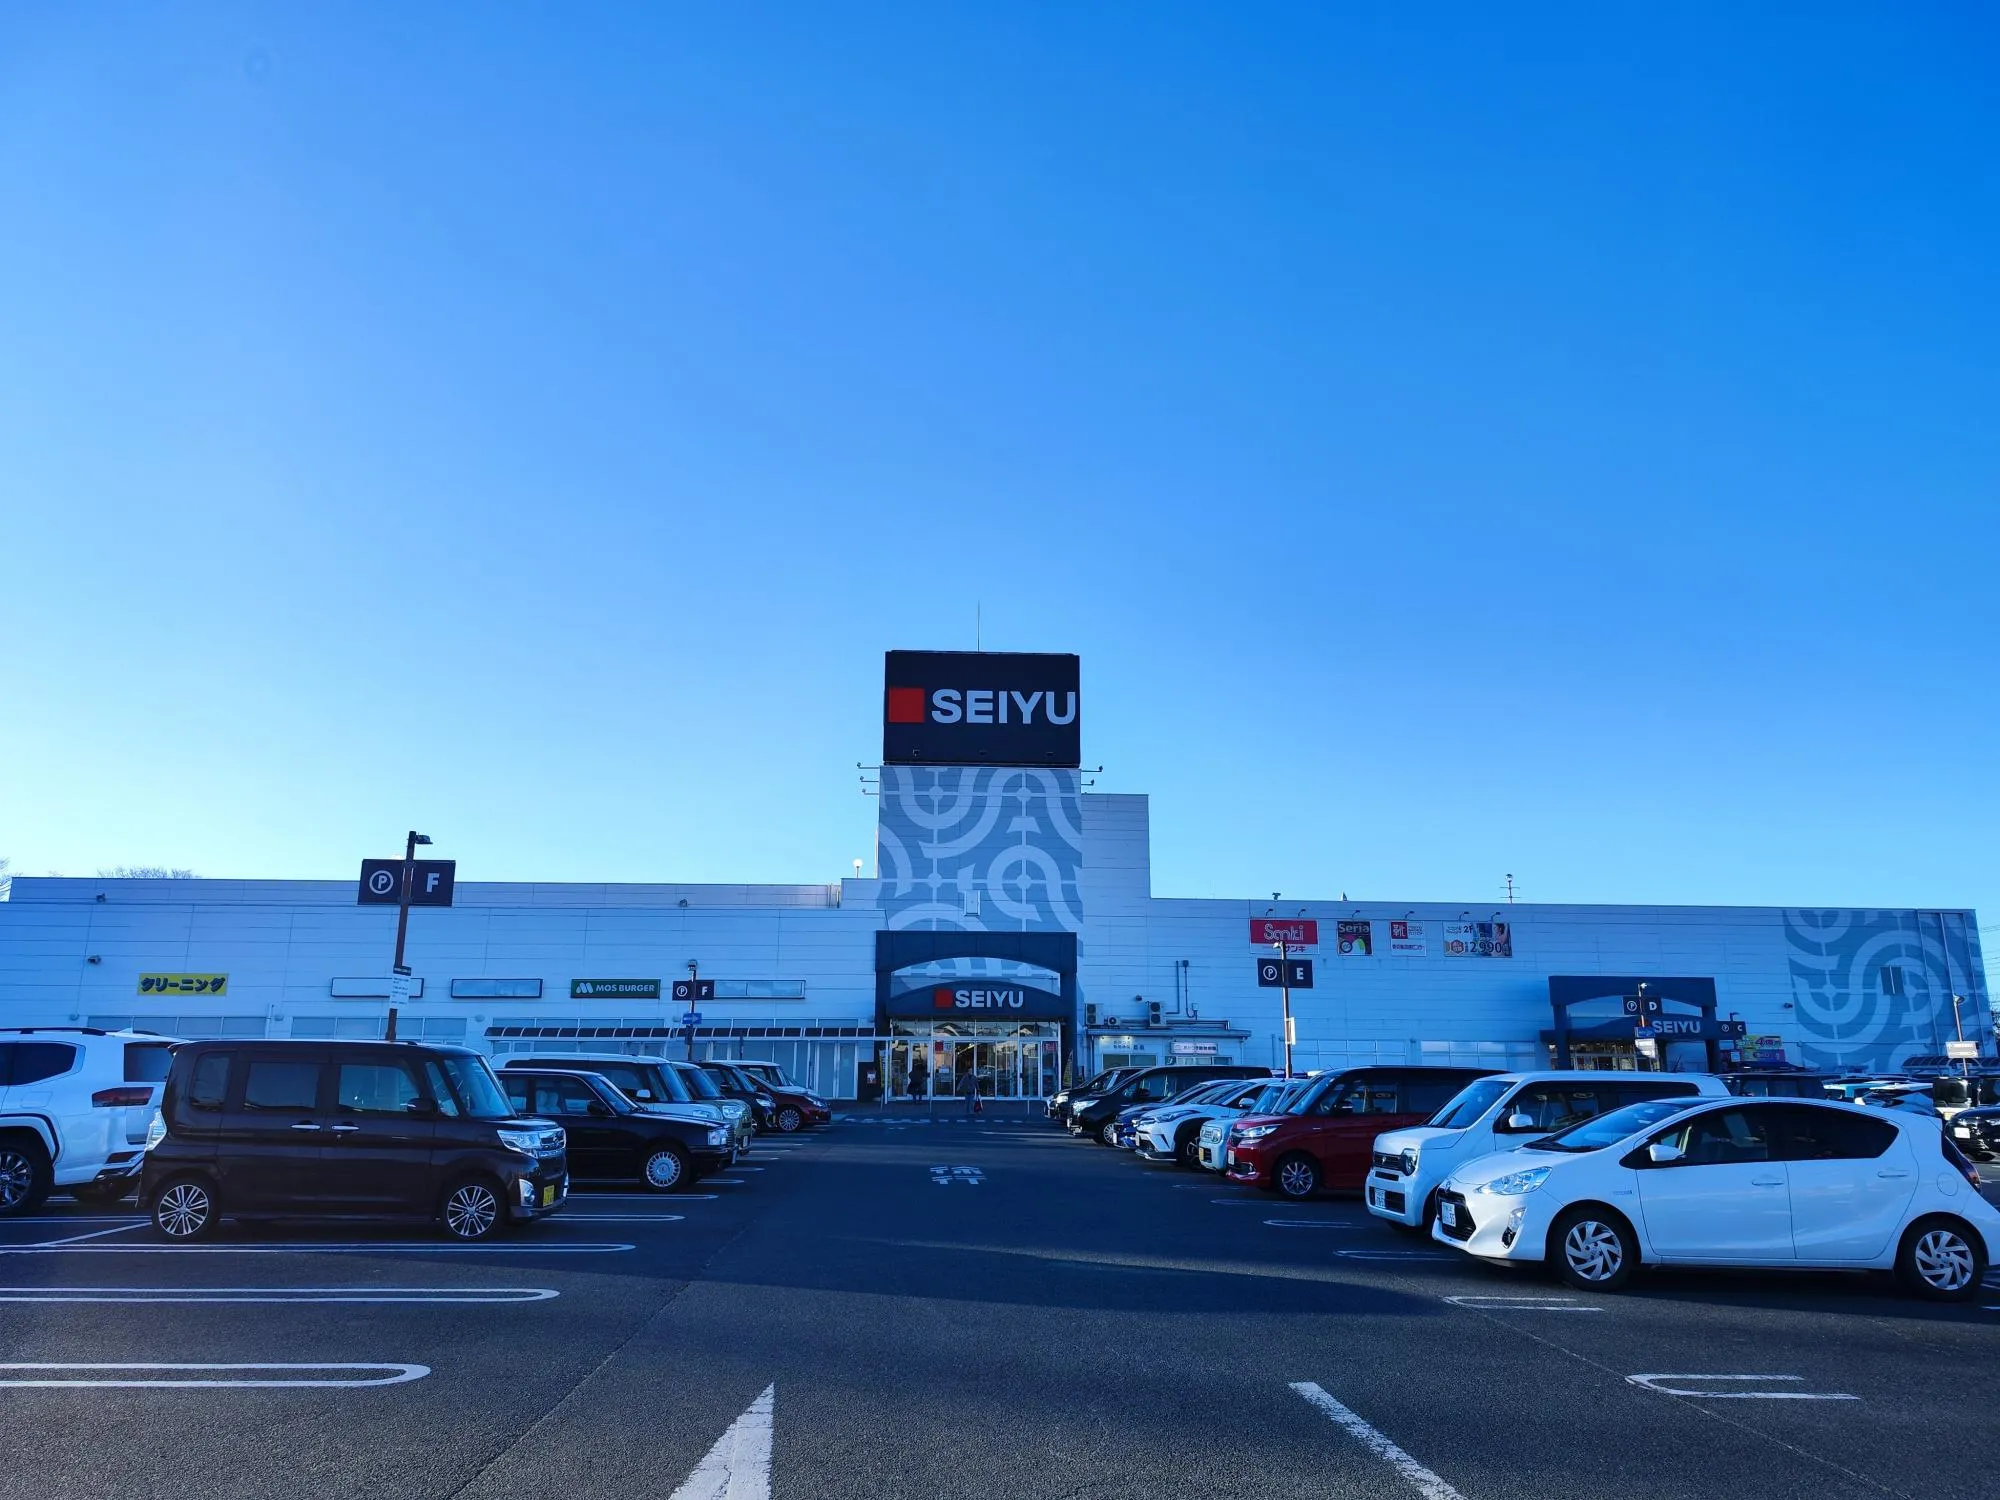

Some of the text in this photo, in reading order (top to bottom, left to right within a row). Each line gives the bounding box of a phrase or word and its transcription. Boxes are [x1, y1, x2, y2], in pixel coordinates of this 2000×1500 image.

[931, 688, 1076, 725] SEIYU
[426, 872, 440, 893] F
[1263, 923, 1304, 941] Sanki
[1338, 923, 1370, 933] Seria
[1296, 967, 1304, 980] E
[140, 977, 226, 992] クリーニング
[595, 984, 655, 992] MOS BURGER
[701, 986, 708, 995] F
[955, 989, 1024, 1008] SEIYU
[1649, 1001, 1657, 1011] D
[1651, 1020, 1700, 1034] SEIYU
[1737, 1024, 1743, 1032] C
